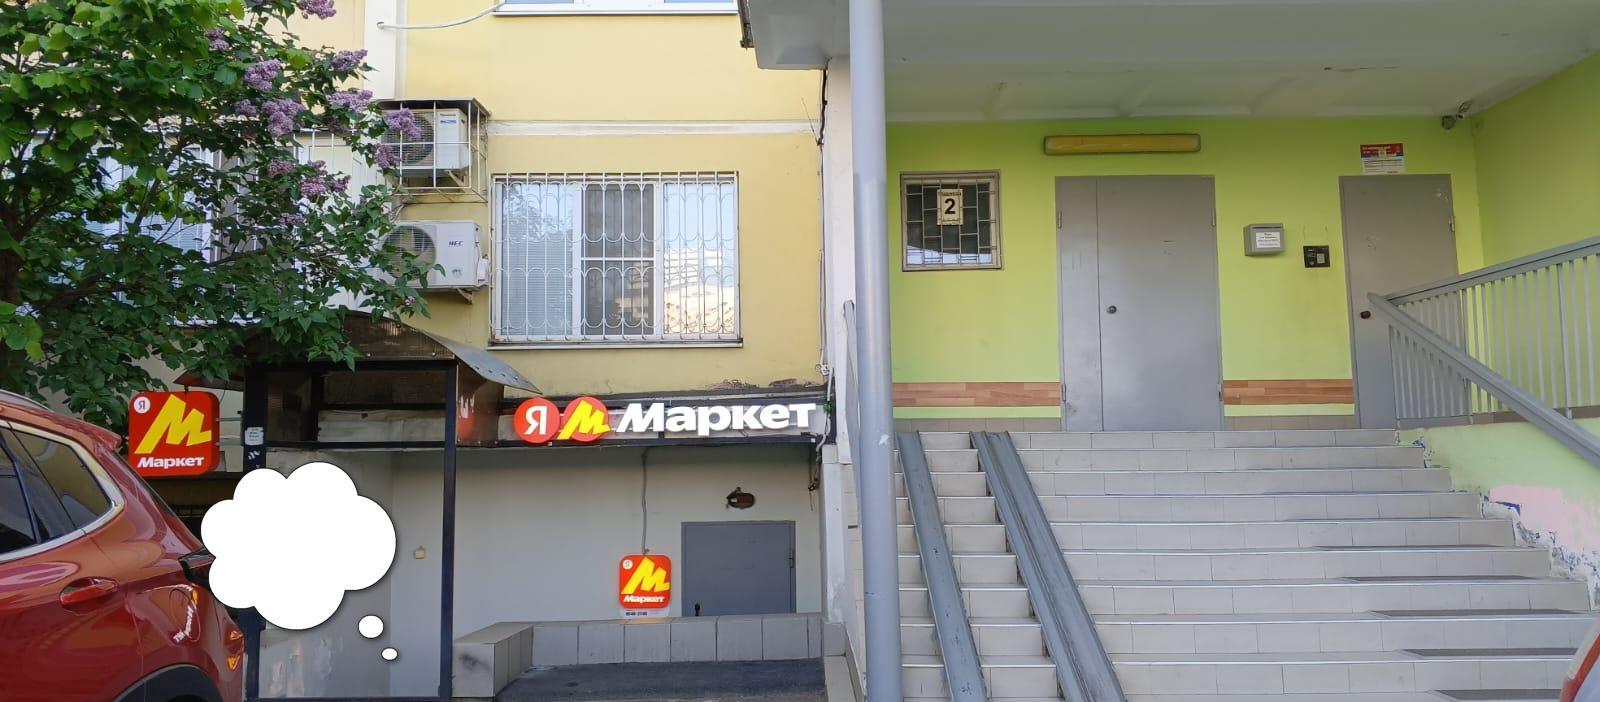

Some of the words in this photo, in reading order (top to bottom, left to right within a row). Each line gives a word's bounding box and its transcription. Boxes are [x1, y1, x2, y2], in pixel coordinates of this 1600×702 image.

[944, 198, 956, 214] 2
[524, 405, 547, 435] Я
[616, 402, 817, 436] Маркет
[137, 456, 205, 469] Маркет
[623, 595, 665, 603] Маркет
